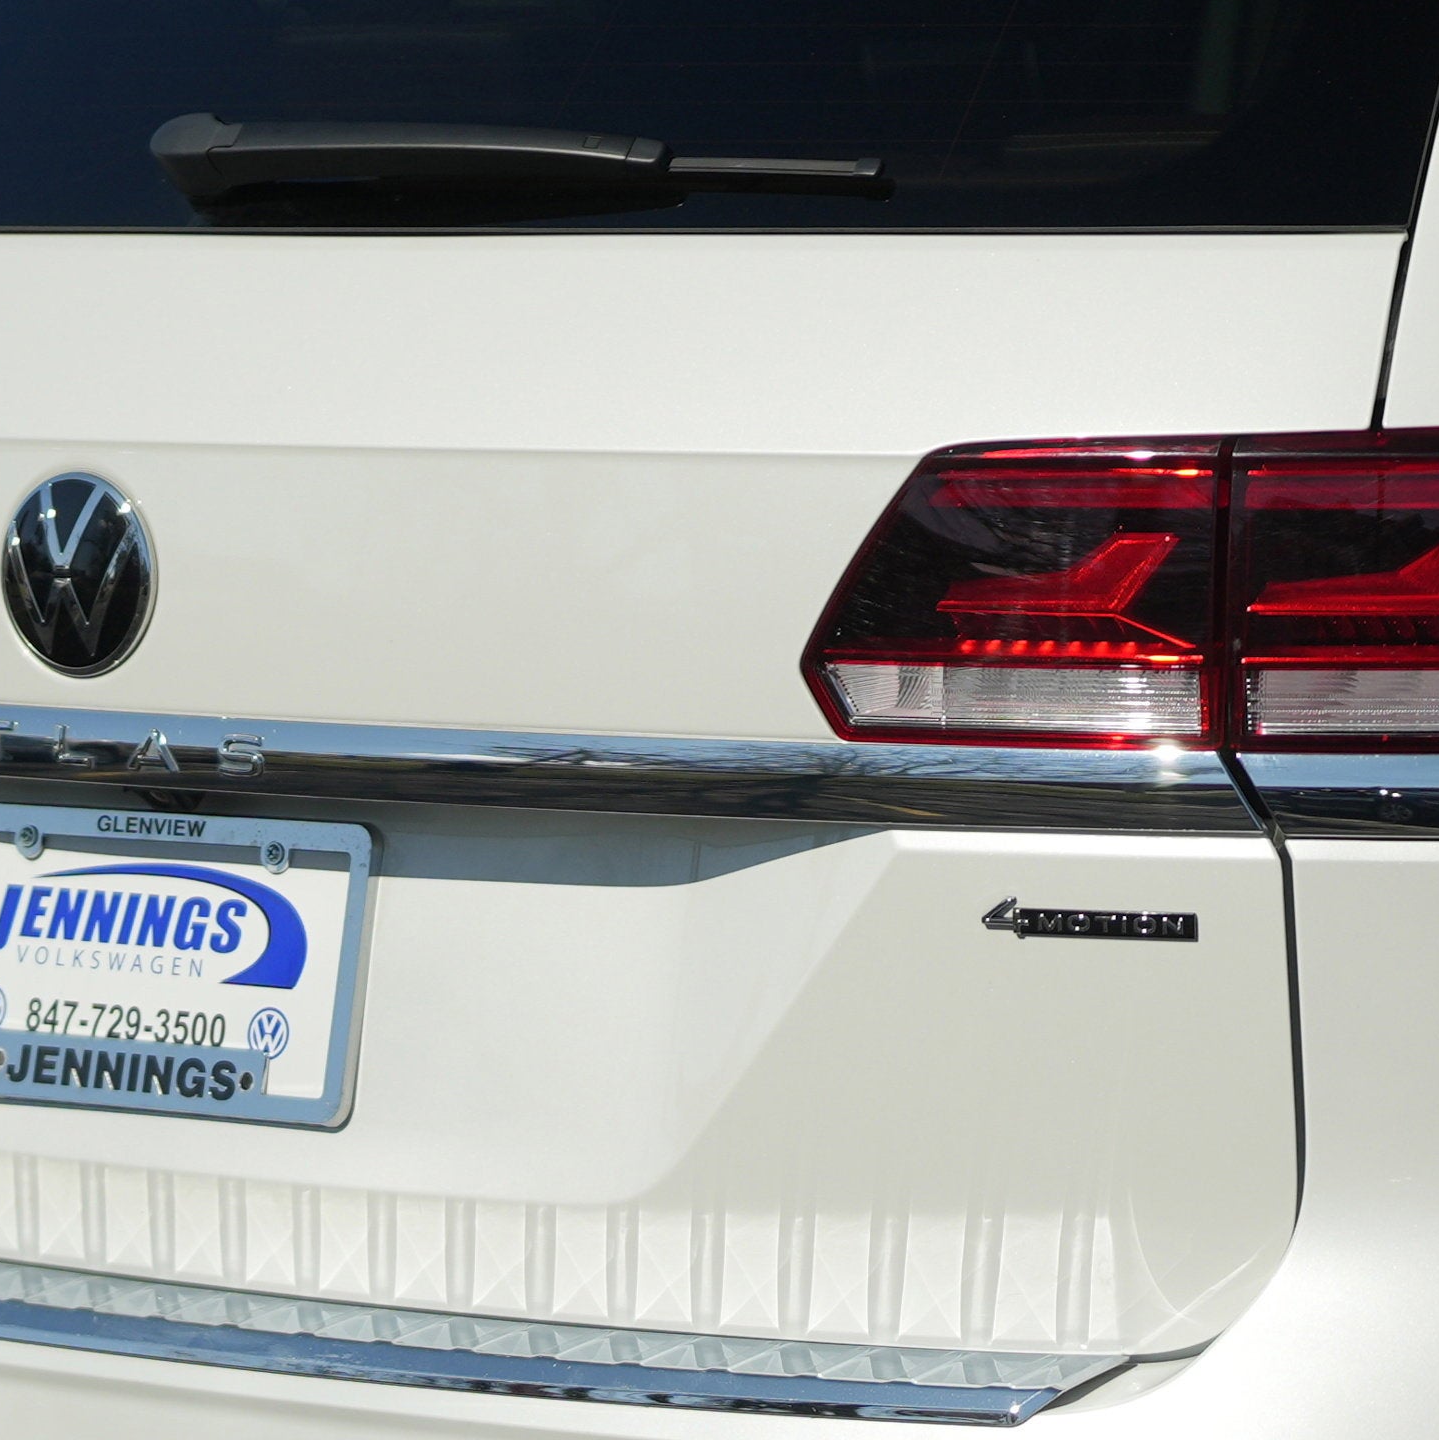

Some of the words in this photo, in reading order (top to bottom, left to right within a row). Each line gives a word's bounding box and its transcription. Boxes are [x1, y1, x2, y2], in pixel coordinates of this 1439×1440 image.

[96, 814, 207, 838] GLENVIEW
[16, 944, 204, 978] VOLKSWAGEN
[25, 997, 226, 1047] 847-729-3500
[6, 1044, 238, 1101] JENNINGS
